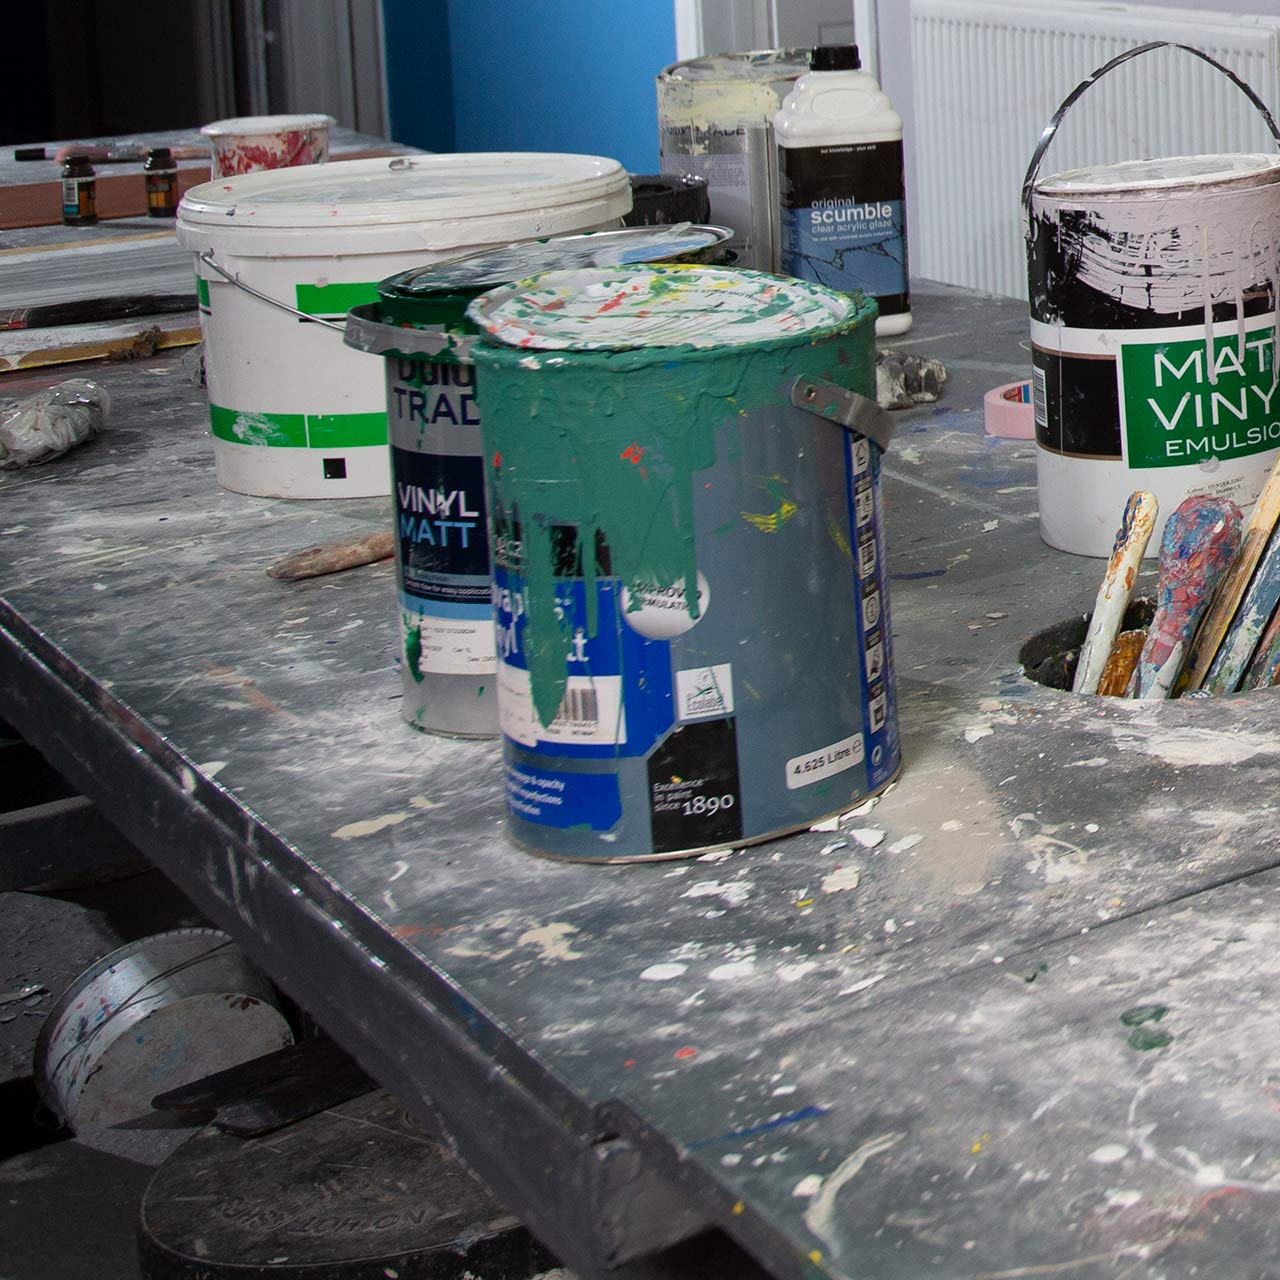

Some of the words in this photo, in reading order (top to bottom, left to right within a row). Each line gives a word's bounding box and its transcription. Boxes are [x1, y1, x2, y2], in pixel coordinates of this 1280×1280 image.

[811, 195, 855, 209] original
[811, 202, 893, 224] scumble
[811, 223, 834, 233] clear
[837, 220, 868, 233] acrylic
[398, 481, 479, 517] VINYL
[401, 513, 476, 548] MATT
[793, 756, 825, 775] 4.625
[827, 747, 851, 764] Litre
[653, 778, 706, 792] Excellence
[681, 794, 734, 816] 1890
